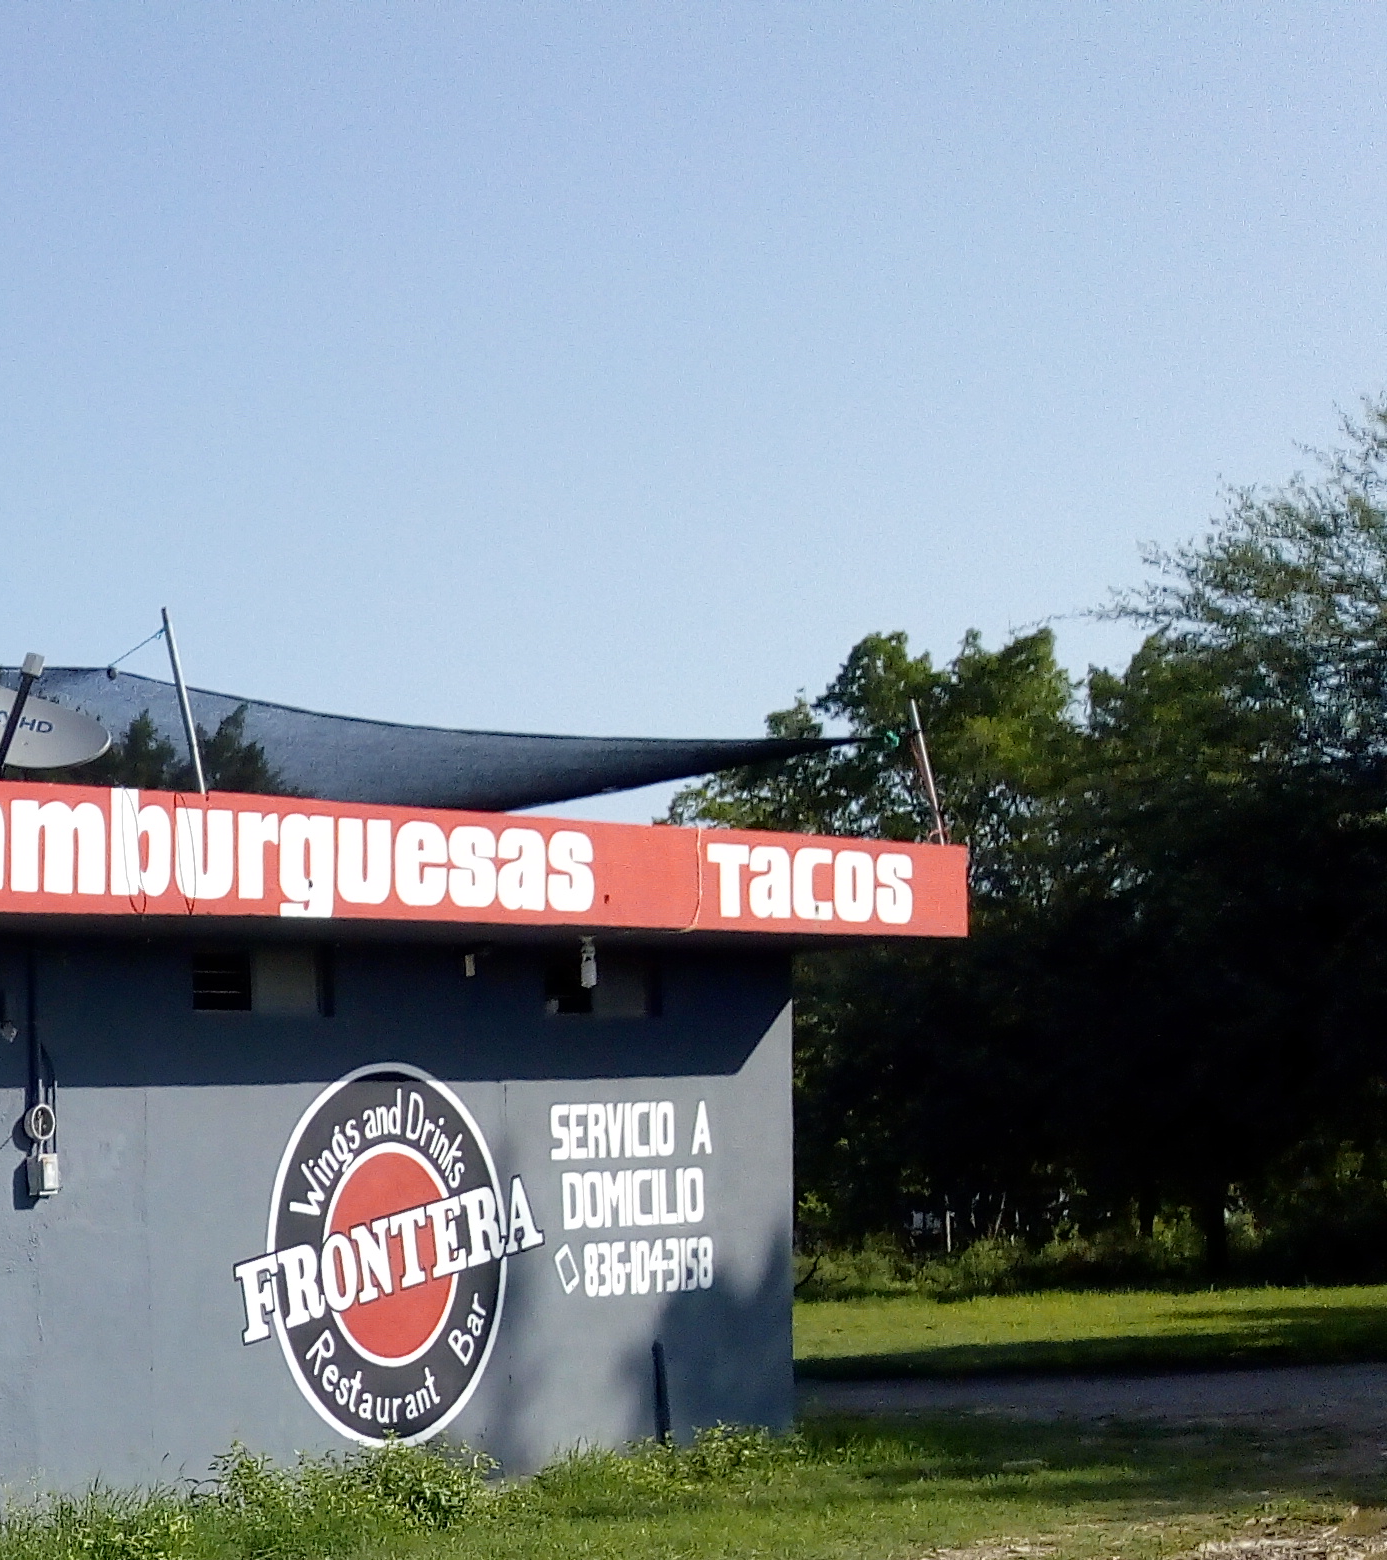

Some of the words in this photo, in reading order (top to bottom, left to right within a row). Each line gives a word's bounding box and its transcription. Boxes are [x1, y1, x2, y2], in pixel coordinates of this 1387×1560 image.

[19, 715, 53, 733] HD
[289, 1118, 361, 1217] Wings
[363, 1088, 403, 1139] and
[406, 1091, 466, 1189] Drinks
[550, 1101, 675, 1160] SERVICIO
[691, 1099, 713, 1155] A
[562, 1167, 705, 1230] DOMICILIO
[233, 1174, 545, 1345] FRONTERA
[306, 1329, 441, 1425] Restaurant
[448, 1292, 489, 1367] Bar
